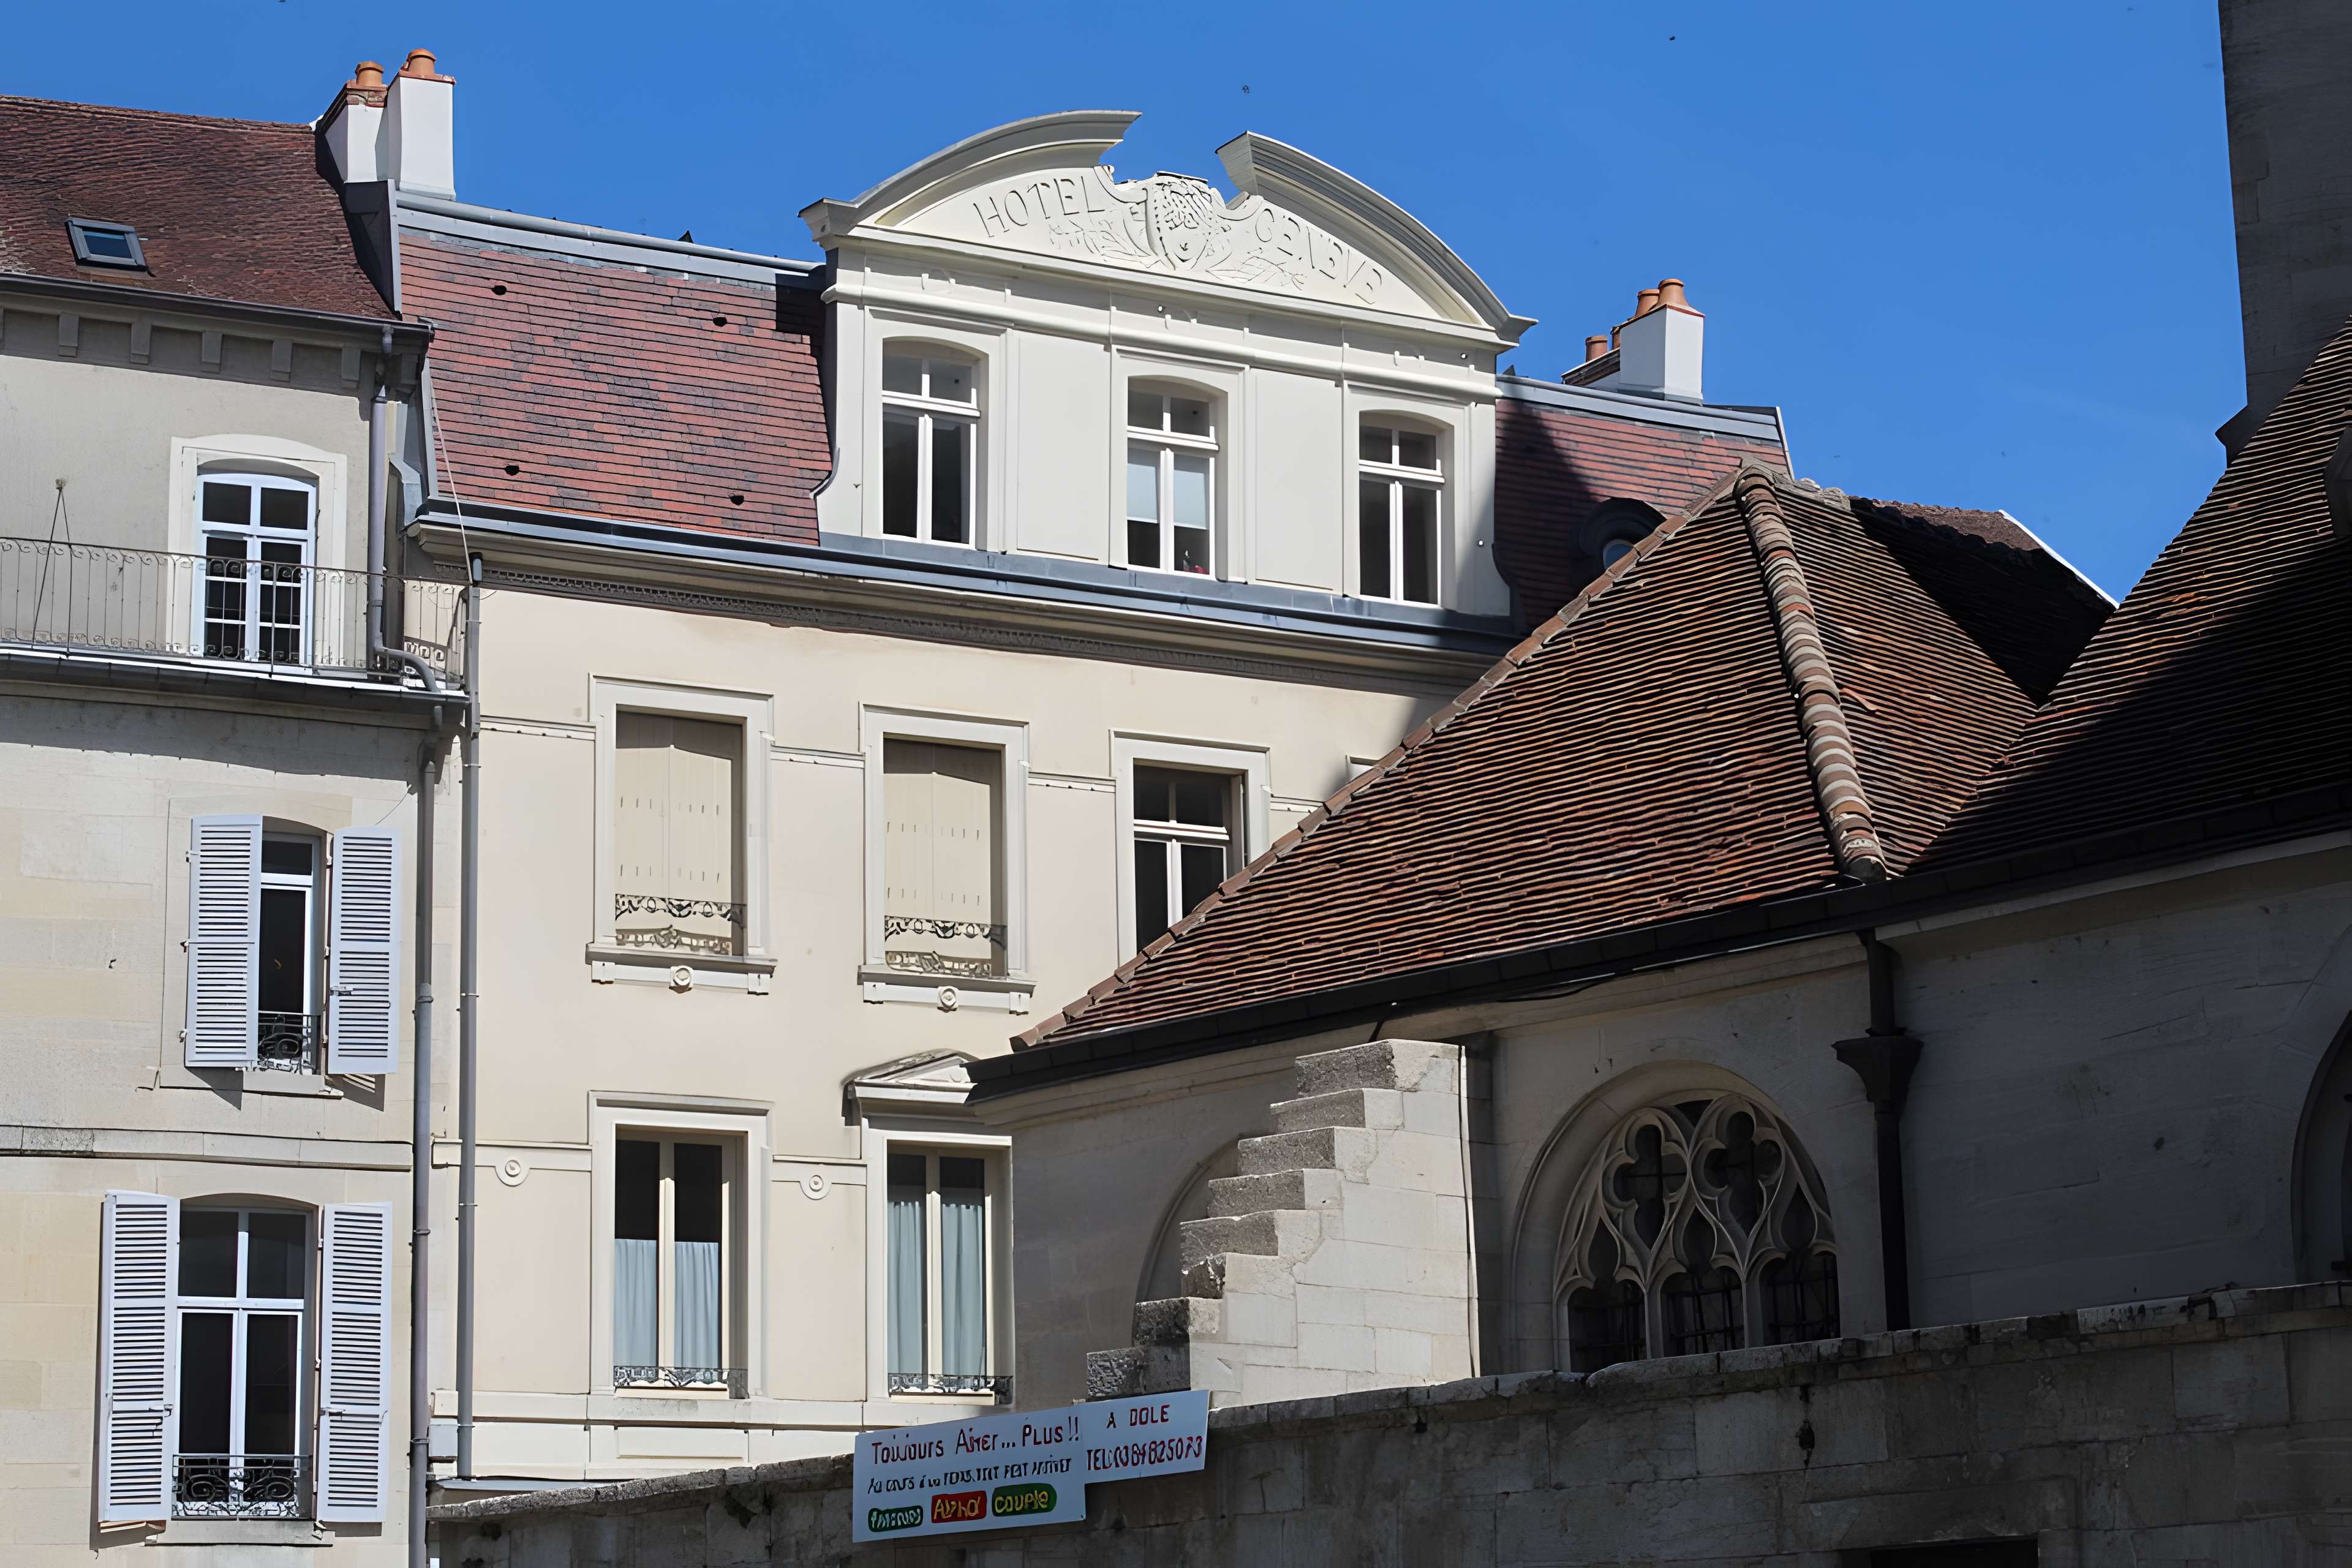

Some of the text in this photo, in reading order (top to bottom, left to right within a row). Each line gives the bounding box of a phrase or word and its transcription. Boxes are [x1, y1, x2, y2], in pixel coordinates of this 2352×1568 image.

[973, 176, 1105, 238] HOTEL
[1107, 1404, 1170, 1428] A DOLE
